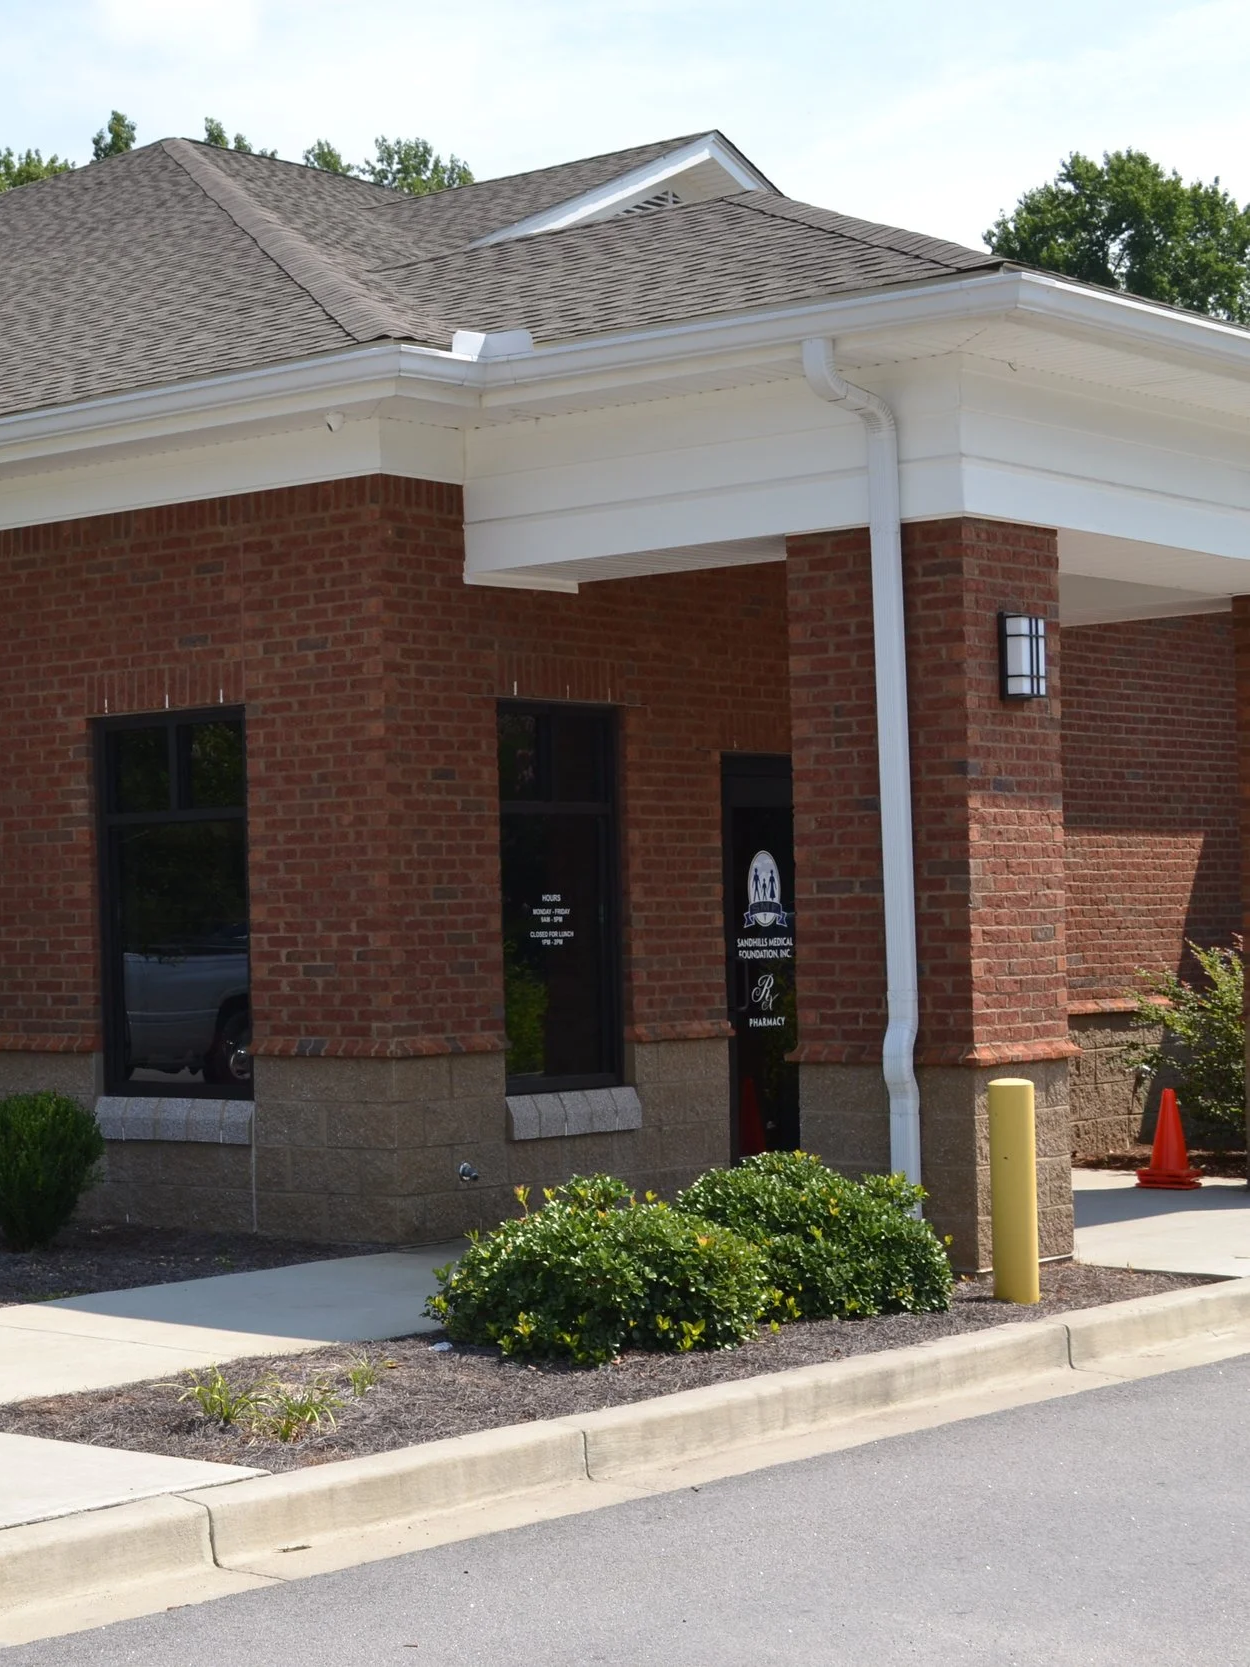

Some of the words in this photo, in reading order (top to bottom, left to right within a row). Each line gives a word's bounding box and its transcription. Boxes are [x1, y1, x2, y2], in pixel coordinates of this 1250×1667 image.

[541, 894, 561, 902] HOURS
[737, 937, 768, 947] SANDHILLS
[768, 937, 794, 947] MEDICAL
[749, 1016, 786, 1027] PHARMACY
